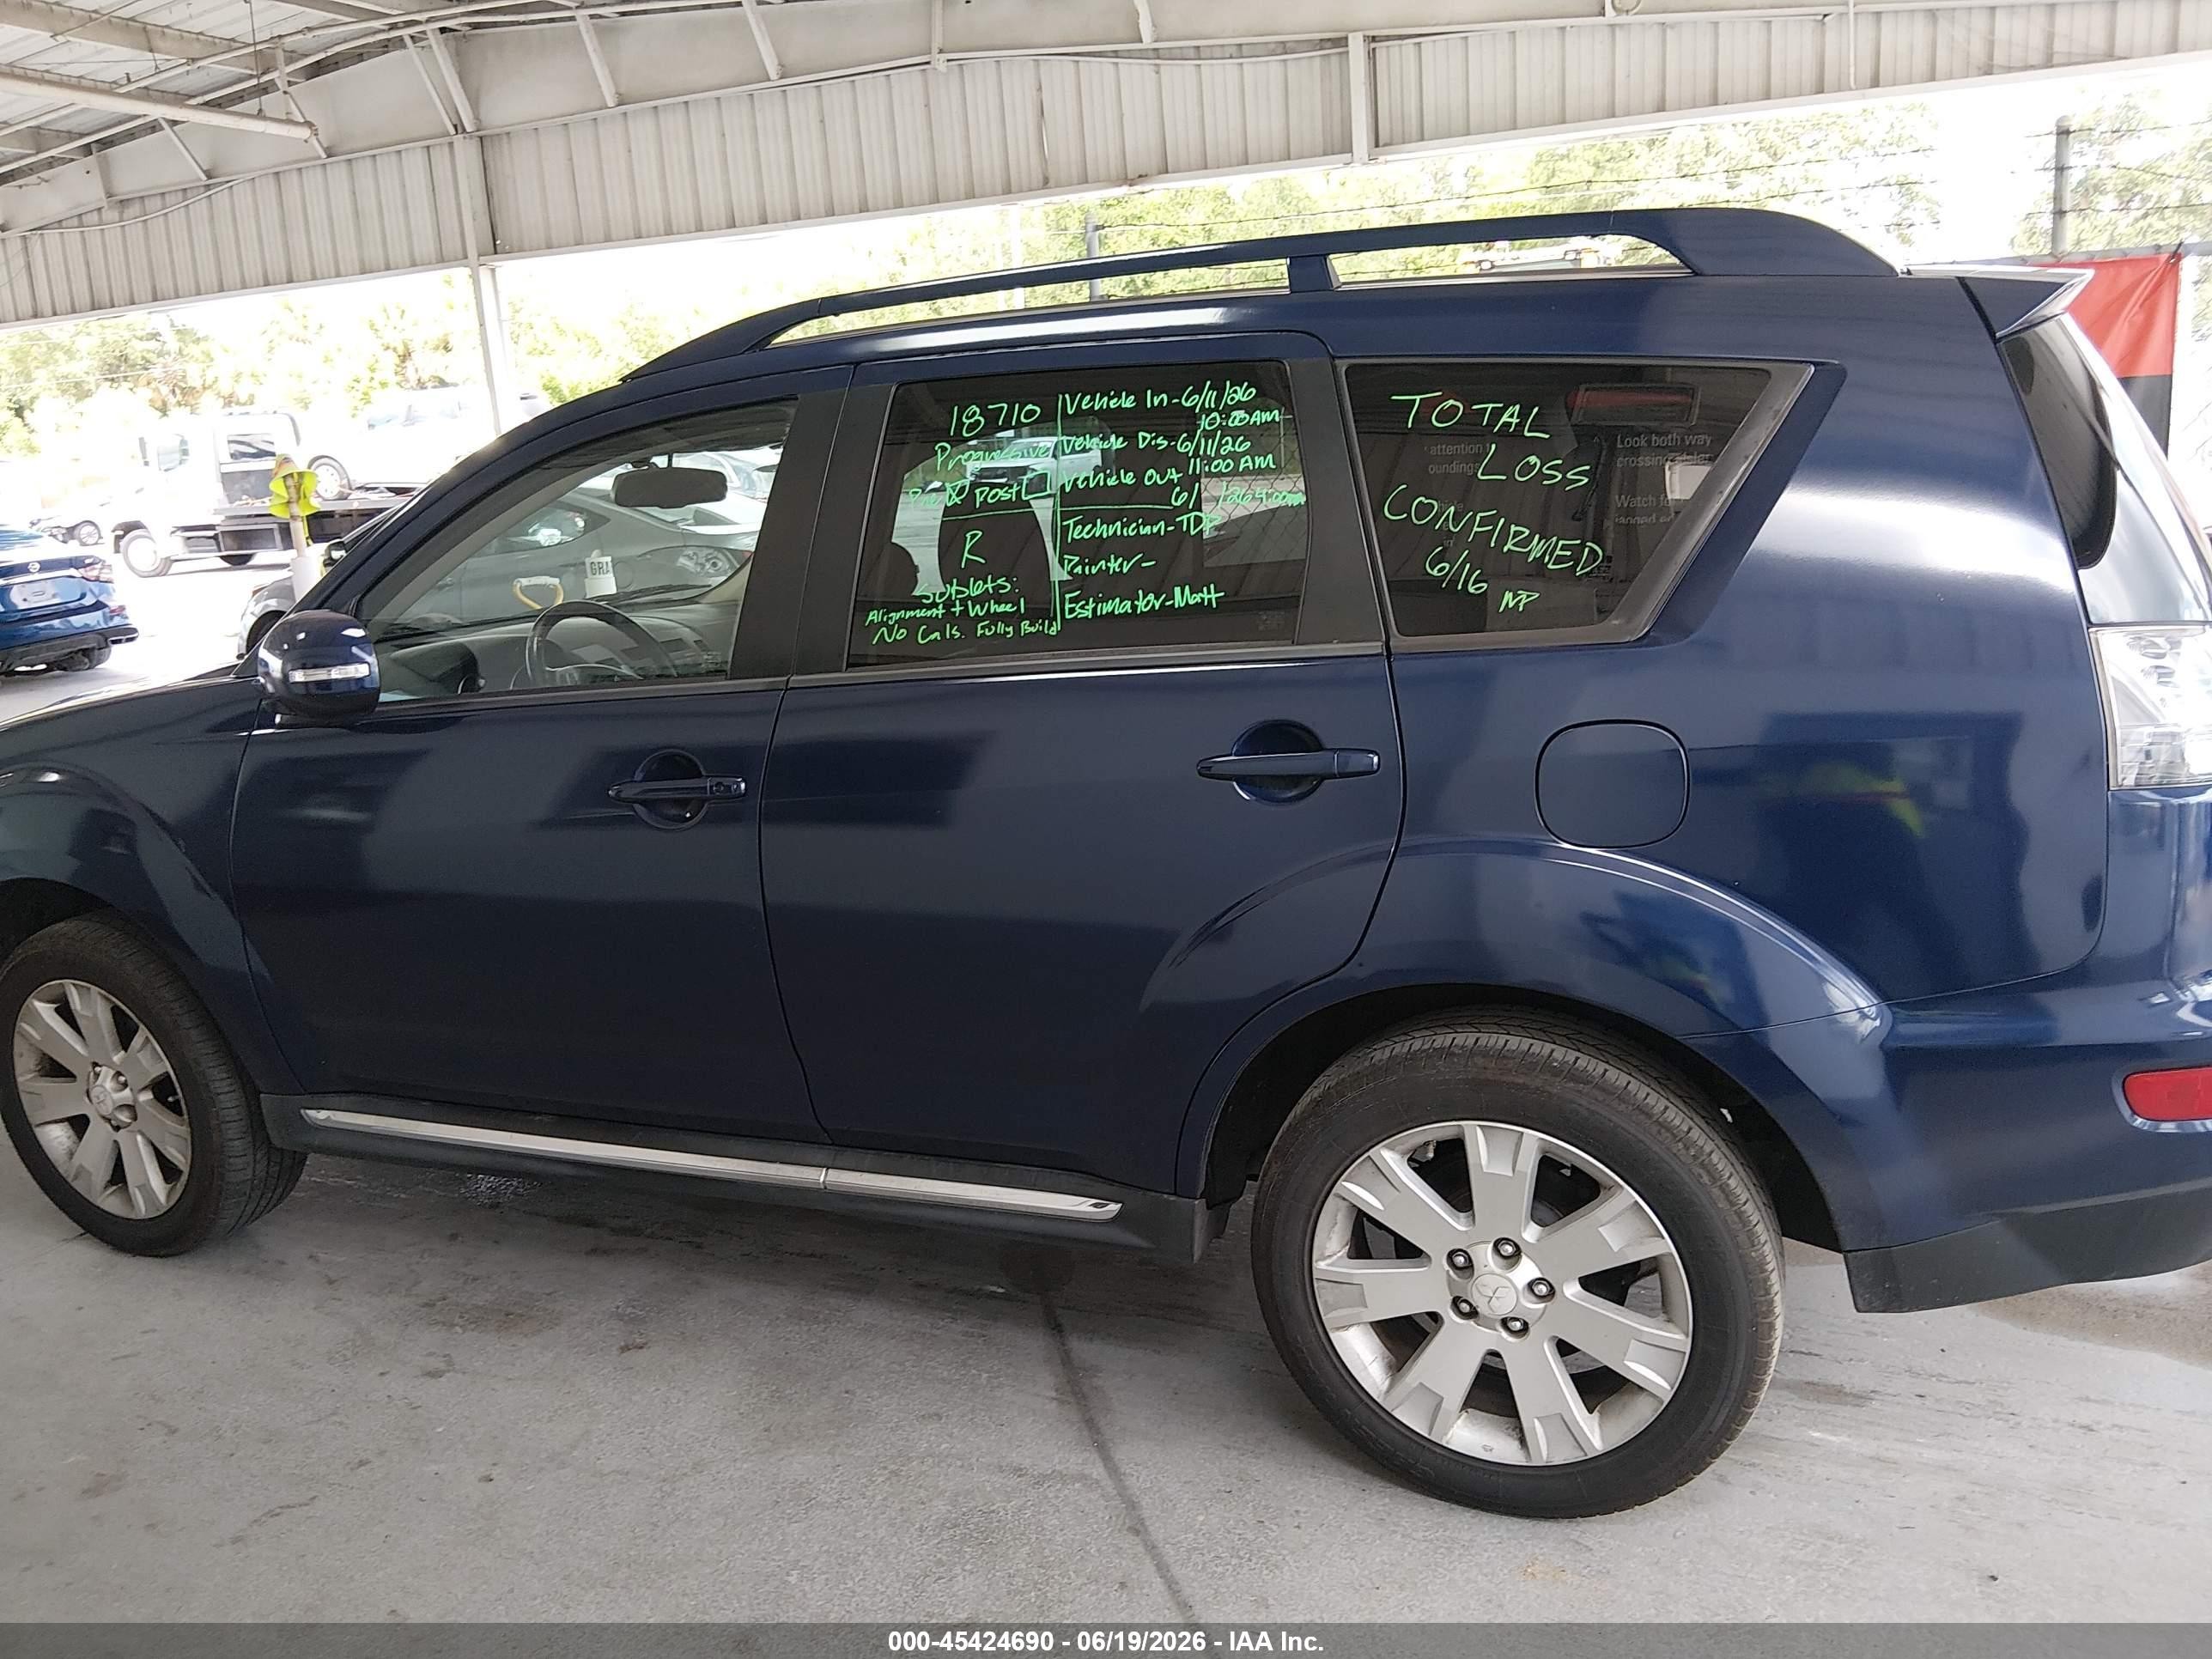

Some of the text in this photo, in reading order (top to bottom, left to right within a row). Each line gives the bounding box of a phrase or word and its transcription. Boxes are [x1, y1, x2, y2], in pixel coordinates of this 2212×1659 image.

[1065, 392, 1136, 415] Vehicle
[1390, 392, 1551, 439] TOTAL
[950, 402, 1042, 438] 18710
[1063, 433, 1127, 454] Vehicle
[1430, 443, 1483, 456] attention
[1616, 434, 1648, 448] Look
[1651, 432, 1680, 447] both
[934, 441, 1049, 471] Progressive
[1188, 457, 1234, 475] 11:00
[1477, 444, 1591, 491] LOSS
[1063, 471, 1183, 493] Vehicle Out
[1615, 494, 1657, 507] Watch
[1383, 484, 1604, 577] CONFIRMED
[961, 530, 987, 568] R
[1425, 546, 1489, 595] 6/16
[865, 603, 946, 626] Alignment
[968, 597, 1024, 617] Wheel
[872, 623, 908, 645] No
[976, 620, 1013, 638] Fully
[1020, 618, 1058, 636] Build
